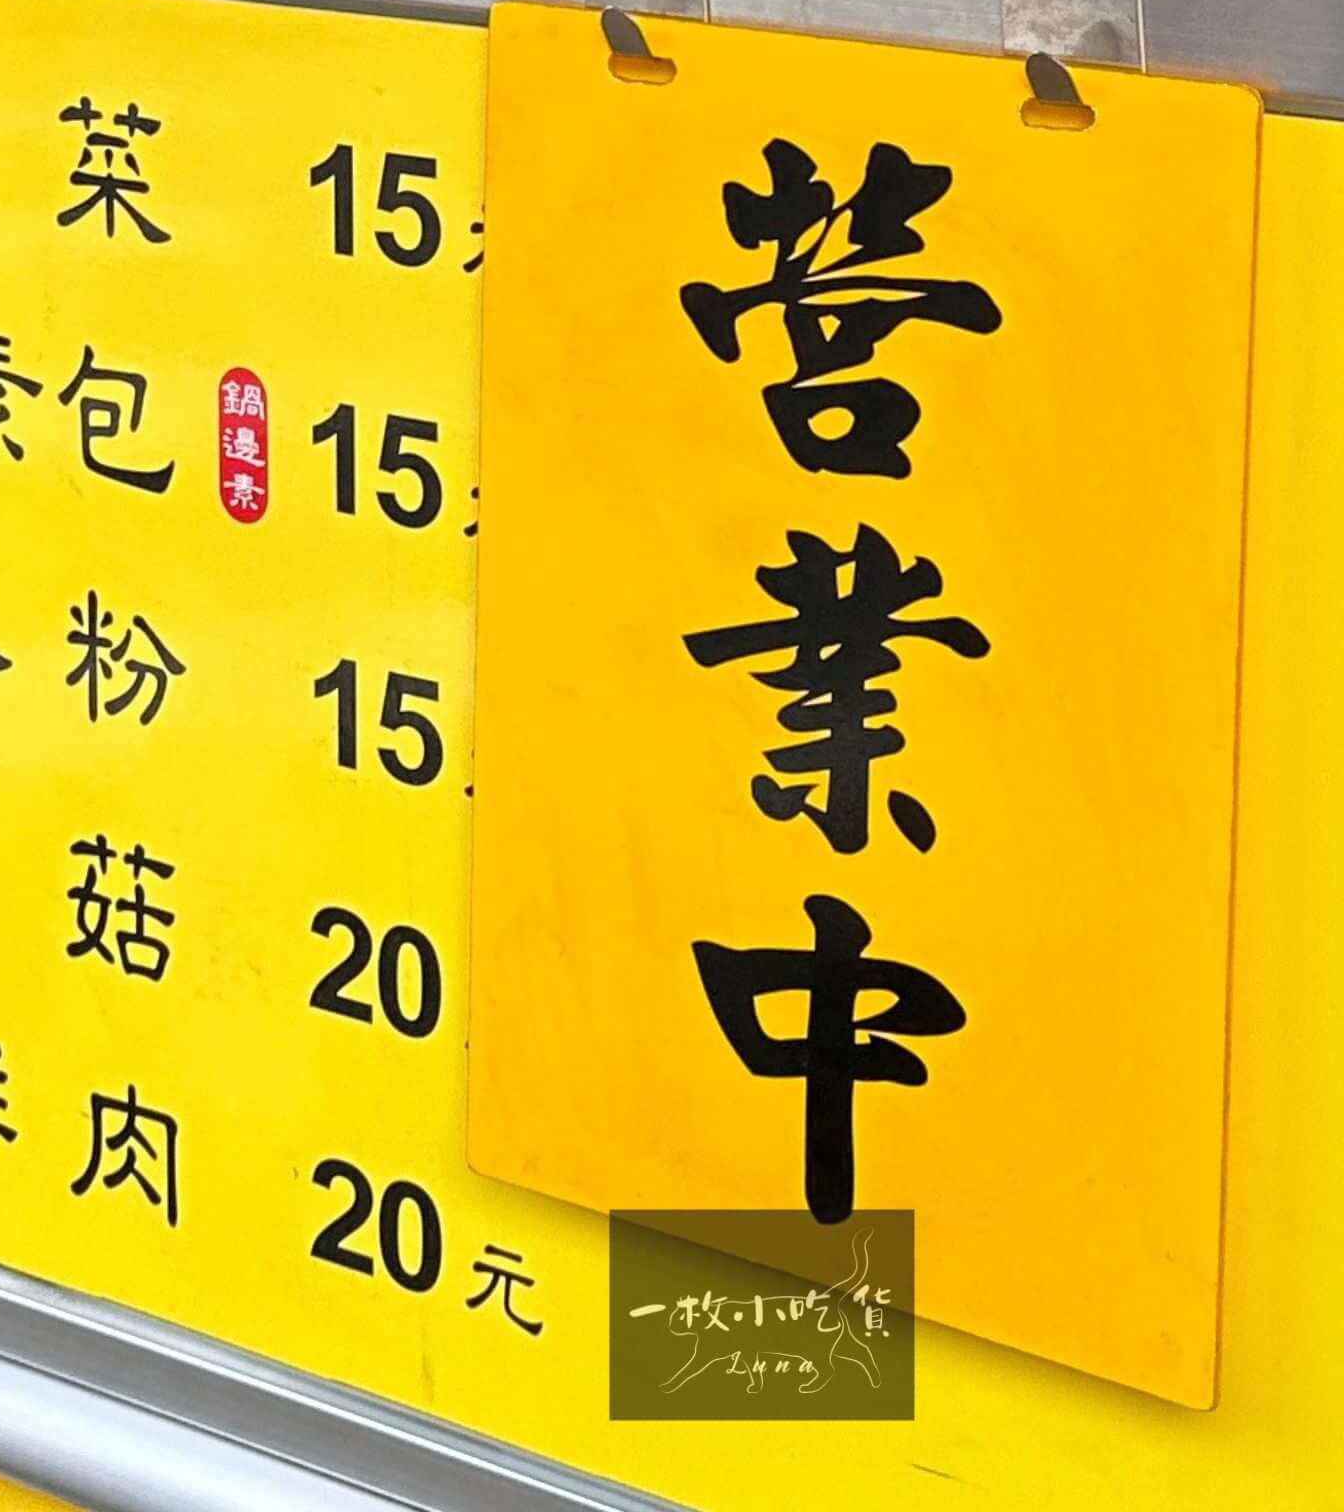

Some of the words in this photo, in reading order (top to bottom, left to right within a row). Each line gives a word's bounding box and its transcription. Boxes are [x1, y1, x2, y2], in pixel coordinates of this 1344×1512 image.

[310, 143, 484, 273] 15
[222, 379, 266, 511] 鍋邊素
[312, 403, 479, 536] 15
[314, 658, 475, 796] 15
[680, 138, 1002, 1225] 營業中
